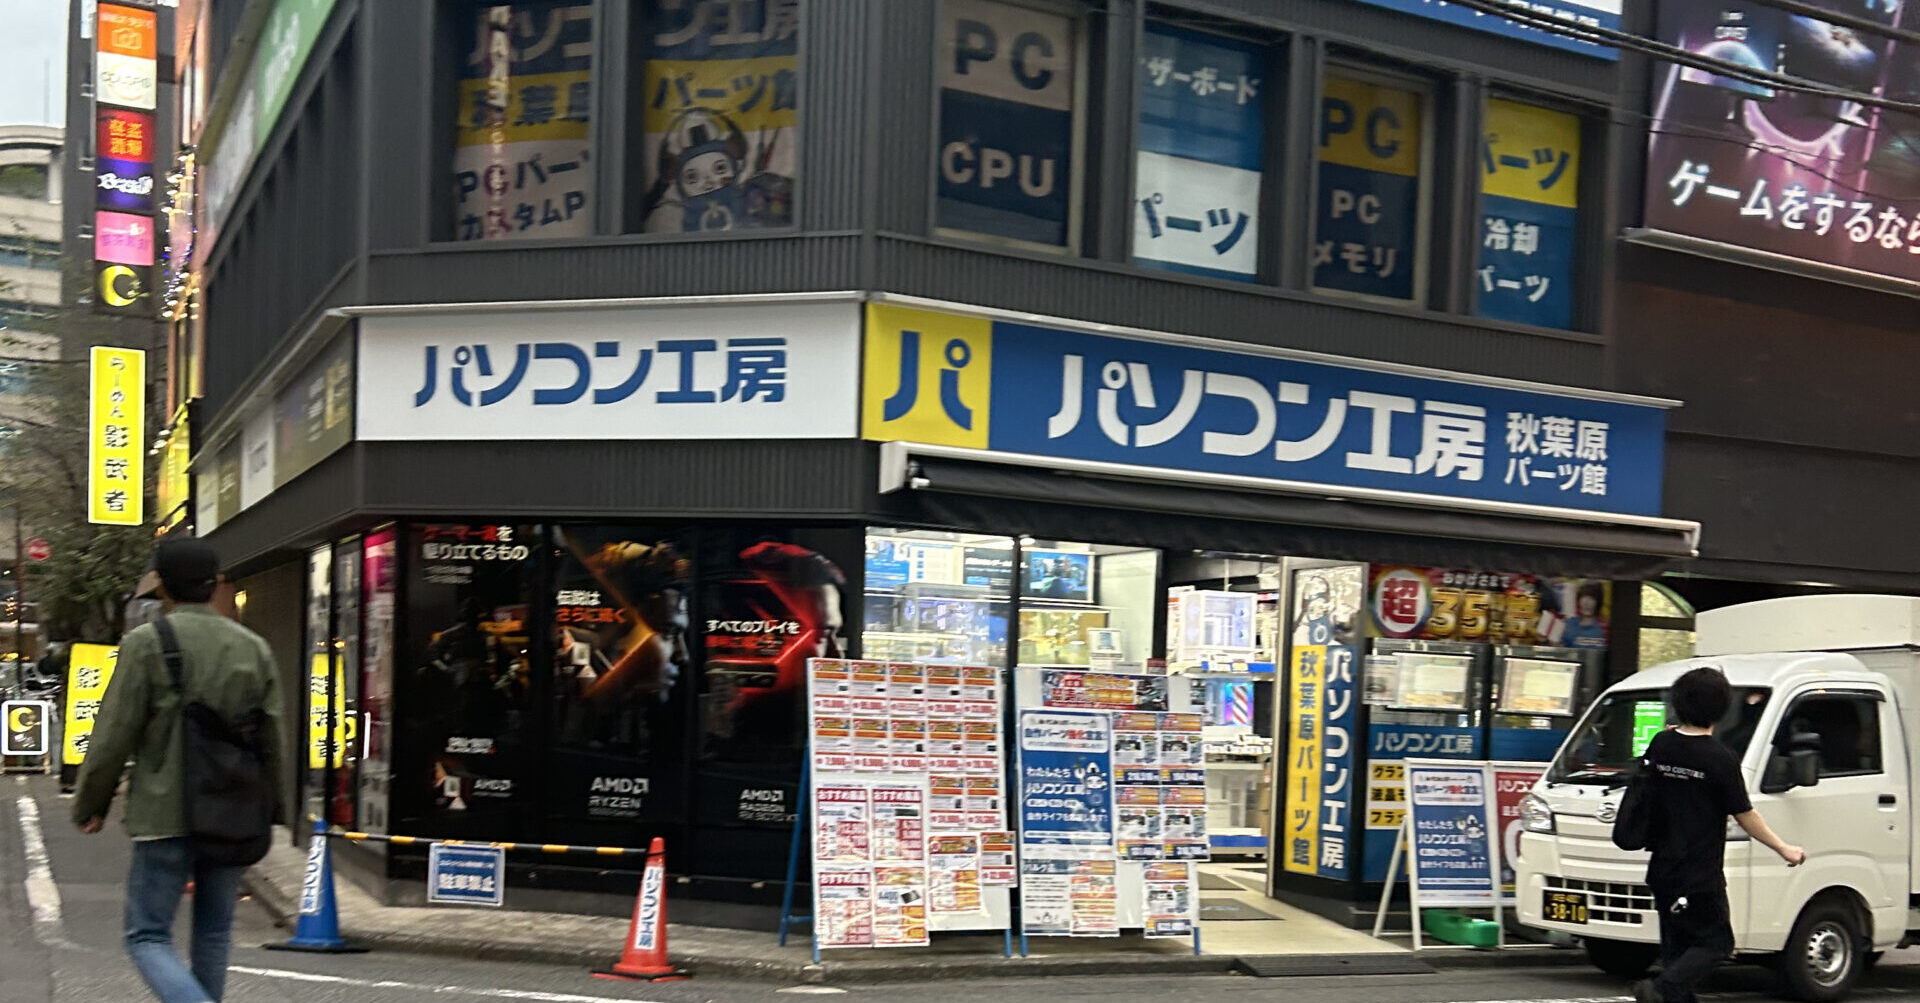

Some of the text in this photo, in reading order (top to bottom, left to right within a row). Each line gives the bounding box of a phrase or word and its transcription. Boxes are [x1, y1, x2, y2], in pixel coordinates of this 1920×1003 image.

[954, 19, 1055, 91] PC
[1139, 56, 1261, 104] ザーボード
[1320, 97, 1400, 159] PC
[940, 140, 1056, 198] CPU
[1331, 189, 1382, 224] PC
[1669, 158, 1920, 255] ゲームをするなら
[1313, 240, 1396, 279] メモリ
[1485, 217, 1539, 255] 冷却
[413, 337, 787, 408] パソコン工房
[883, 330, 973, 430] パ
[1048, 354, 1487, 481] パソコン工房
[1505, 411, 1610, 461] 秋葉原
[103, 424, 129, 512] 影武者
[1503, 463, 1608, 497] パーツ館
[1382, 577, 1421, 626] 超
[1292, 650, 1319, 867] 秋葉原パーツ館
[1321, 648, 1353, 870] パソコン工房
[1375, 732, 1473, 754] パソコン工房
[590, 777, 632, 794] AMD
[741, 789, 770, 801] AMD
[1551, 902, 1586, 922] 38-10
